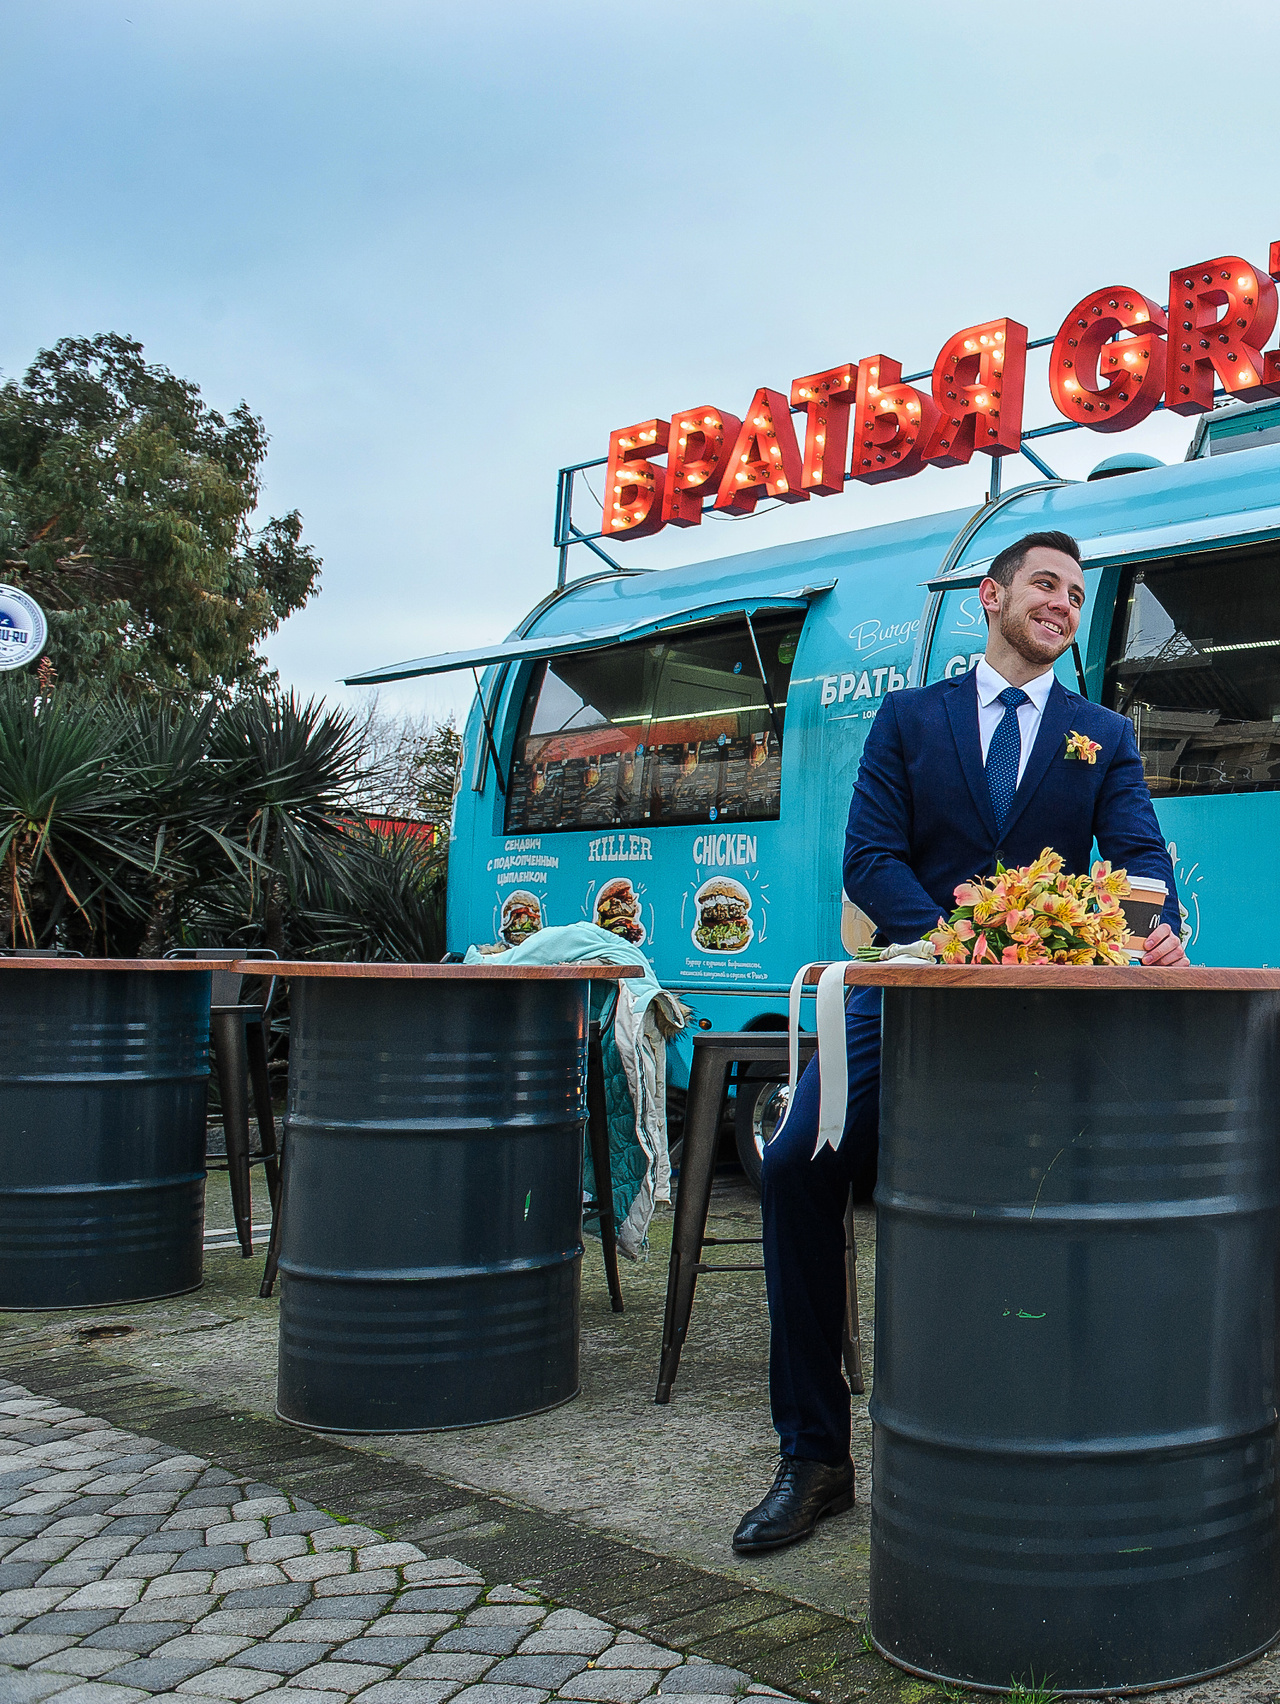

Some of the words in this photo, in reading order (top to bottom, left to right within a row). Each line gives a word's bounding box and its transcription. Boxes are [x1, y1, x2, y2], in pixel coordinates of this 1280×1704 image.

[601, 317, 1028, 540] БРАТЬЯ
[848, 619, 920, 651] Burge
[504, 838, 542, 852] СЕНДВИЧ
[588, 834, 653, 862] KILLER
[692, 833, 757, 867] CHICKEN
[493, 854, 559, 870] ПОДКОПЧЕННЫМ
[497, 871, 547, 887] ЦЫПЛЕНКОМ
